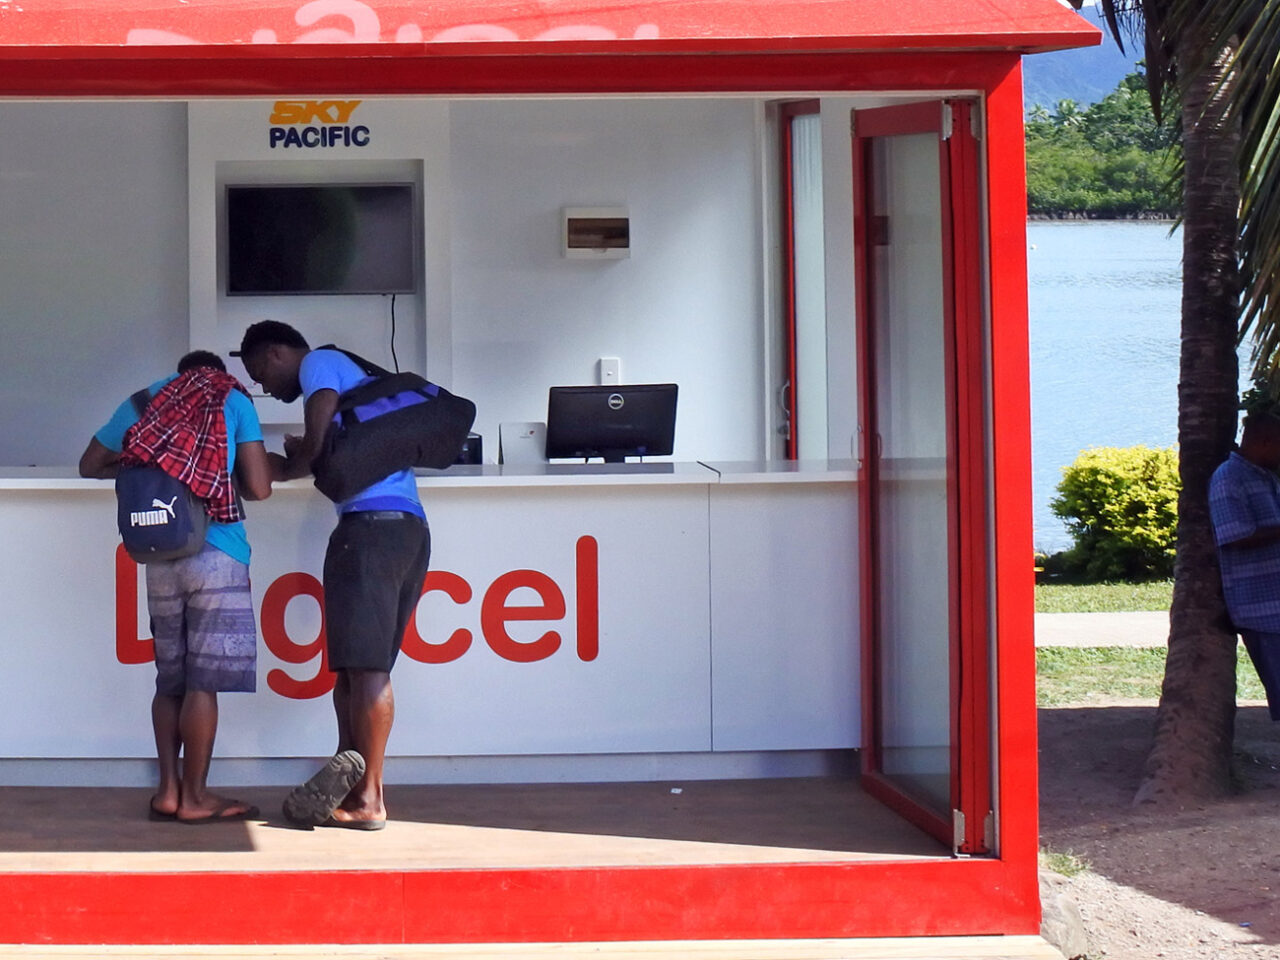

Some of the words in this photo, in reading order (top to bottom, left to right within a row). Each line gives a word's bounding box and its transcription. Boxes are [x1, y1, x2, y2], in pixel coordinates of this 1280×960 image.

[269, 100, 362, 125] SKY
[269, 126, 370, 148] PACIFIC
[130, 509, 169, 527] PUMA
[116, 535, 599, 699] gcel
